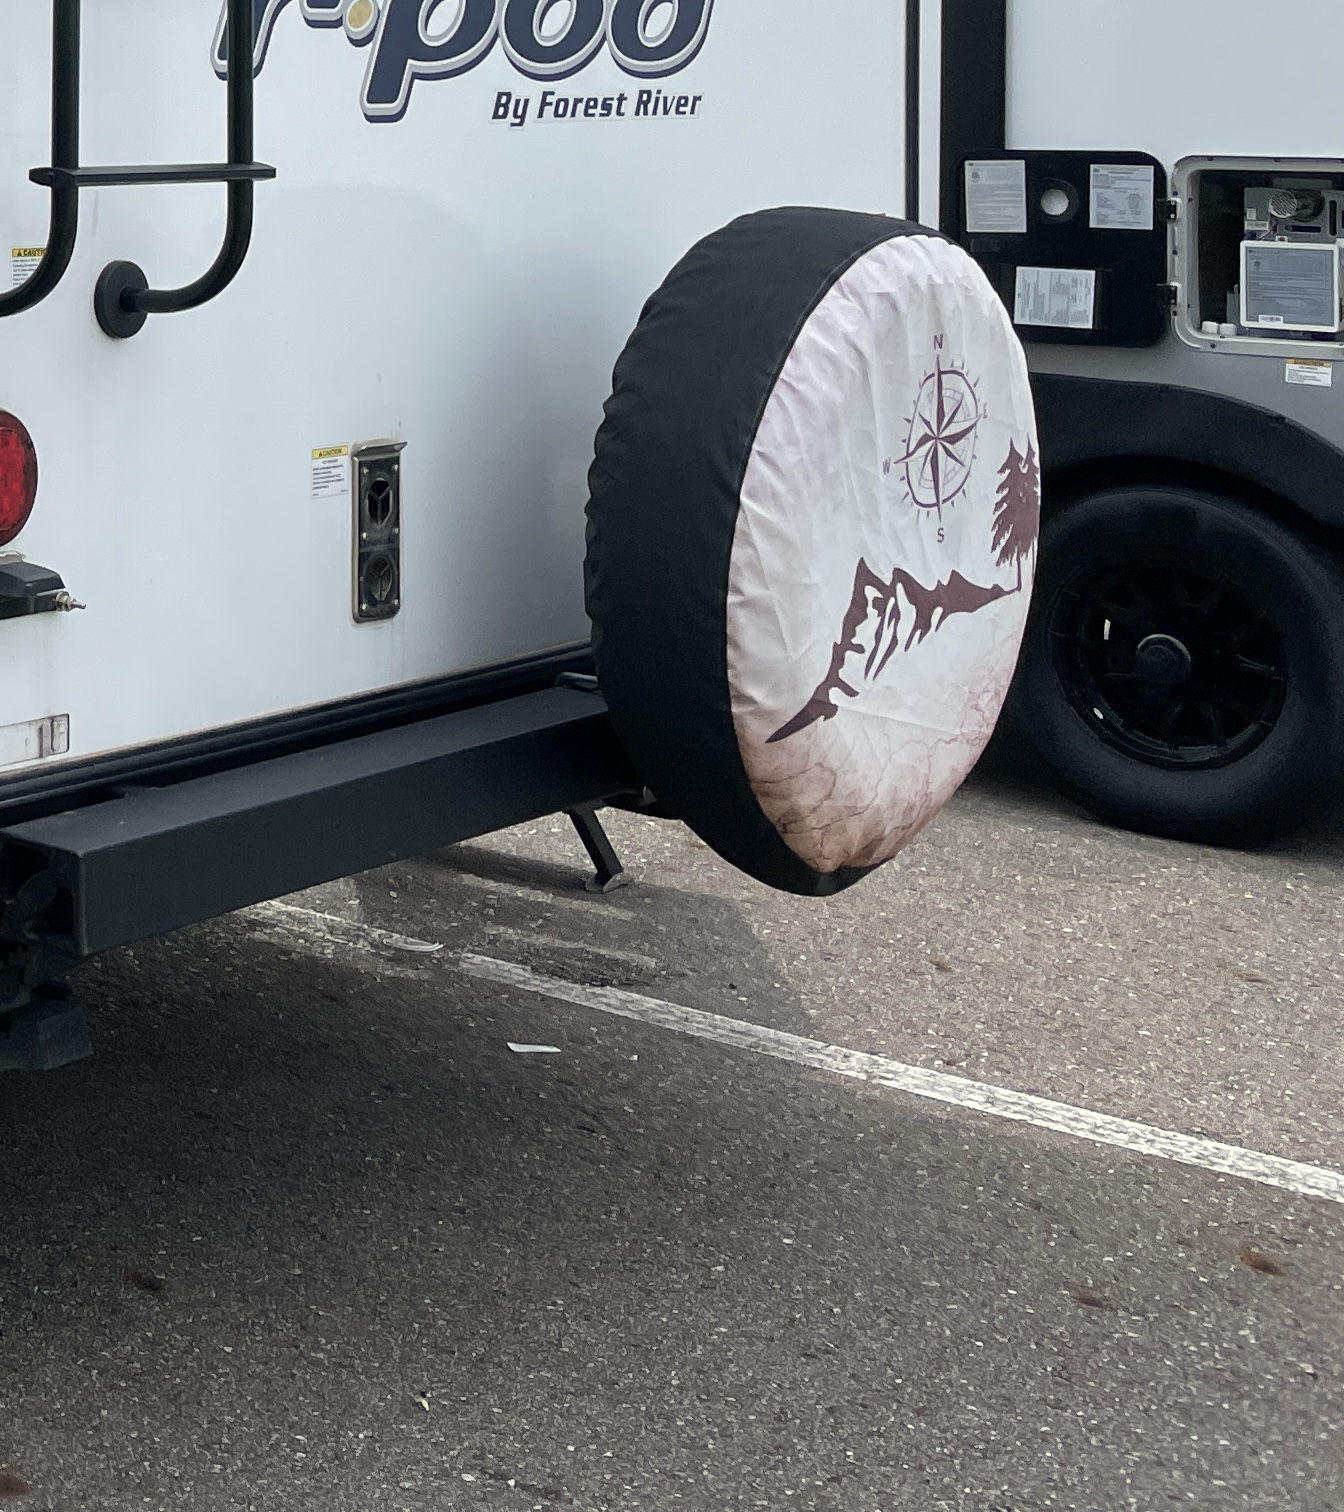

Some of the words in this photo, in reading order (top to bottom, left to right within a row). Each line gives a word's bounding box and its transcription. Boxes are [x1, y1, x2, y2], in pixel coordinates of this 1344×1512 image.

[492, 91, 529, 127] By
[537, 91, 628, 119] Forest
[635, 89, 702, 117] River
[933, 334, 944, 349] N
[937, 528, 945, 543] S
